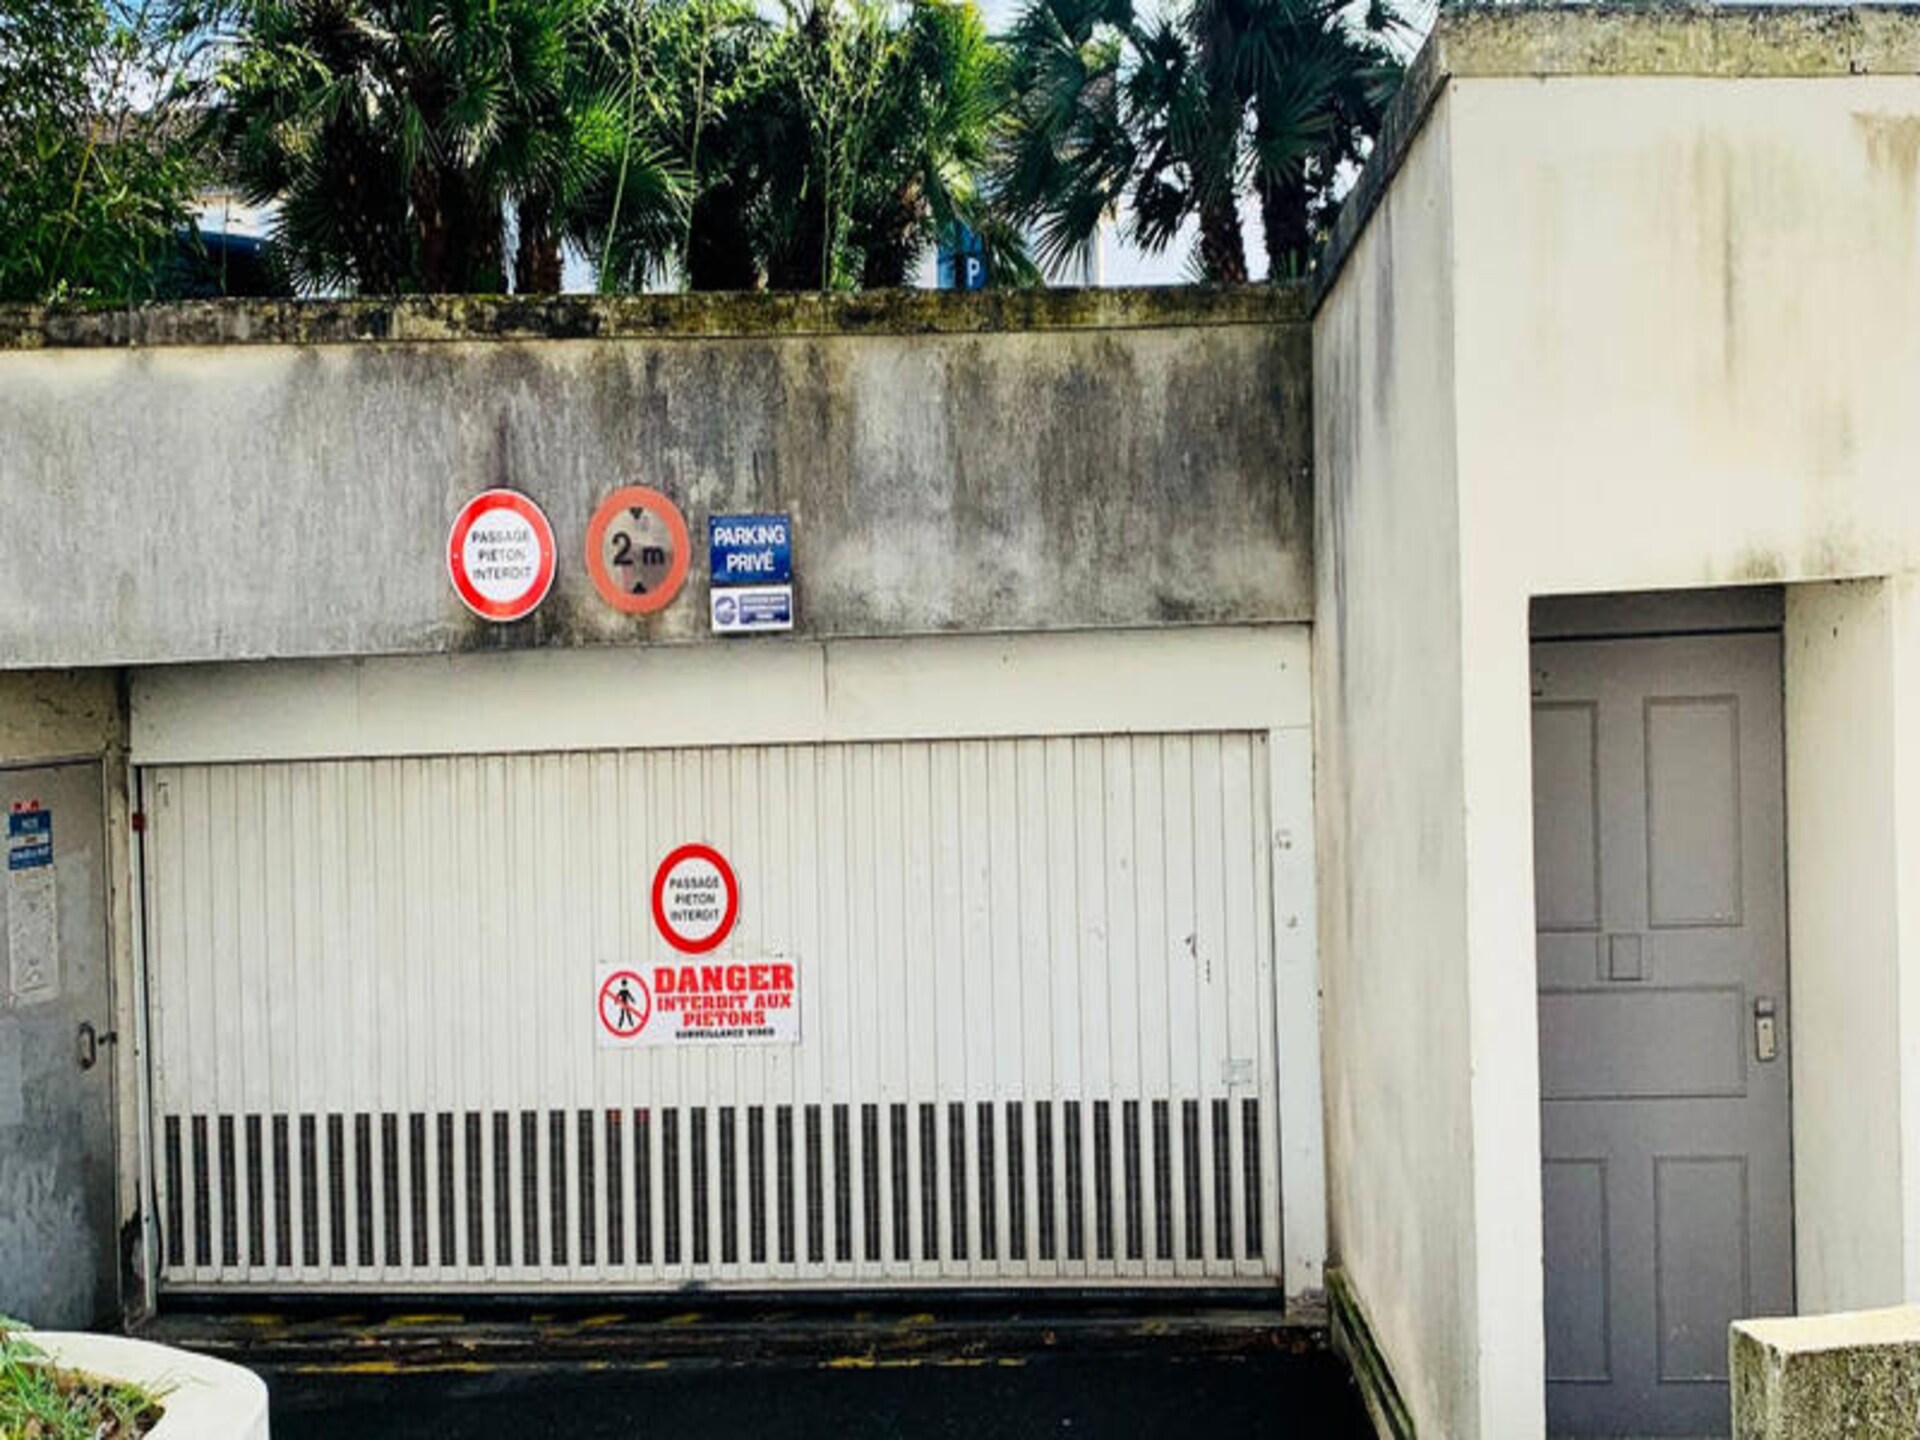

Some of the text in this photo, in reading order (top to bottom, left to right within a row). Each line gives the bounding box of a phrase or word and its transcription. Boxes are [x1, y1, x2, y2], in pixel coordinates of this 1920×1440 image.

[967, 258, 980, 287] P
[472, 530, 529, 543] PASSAGE
[714, 525, 785, 546] PARKING
[479, 549, 526, 561] PIETON
[612, 531, 665, 565] 2 m
[727, 549, 775, 573] PRIVÉ
[473, 567, 531, 580] INTERDIT
[669, 876, 719, 889] PASSAGE
[675, 893, 715, 905] PIETON
[670, 909, 719, 921] INTERDIT
[653, 963, 794, 993] DANGER
[657, 994, 791, 1011] INTERDIT AUX
[683, 1010, 766, 1026] PIETONS
[675, 1029, 744, 1039] SURVEILLANCE
